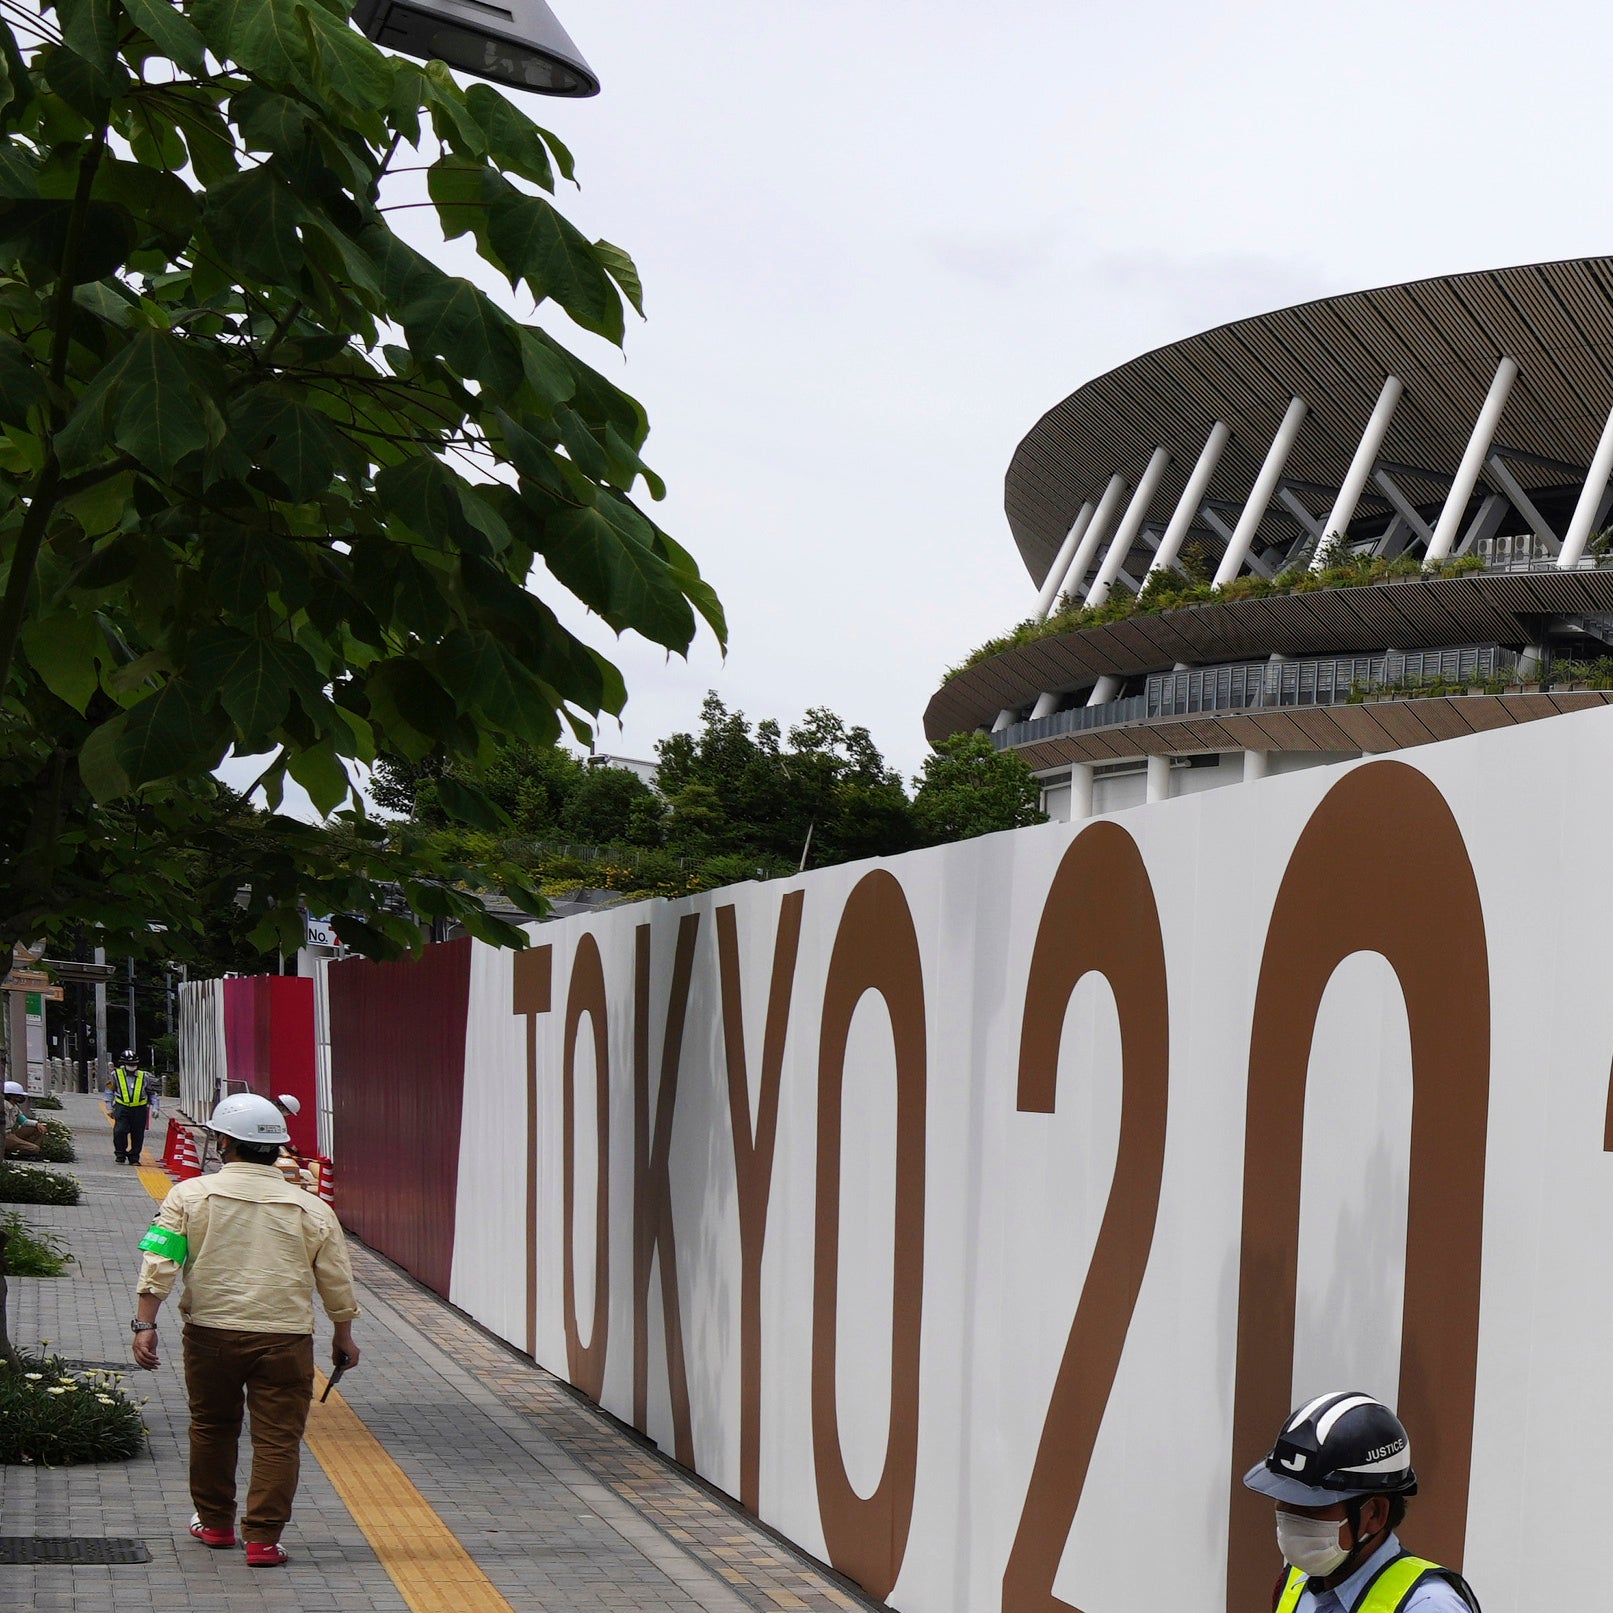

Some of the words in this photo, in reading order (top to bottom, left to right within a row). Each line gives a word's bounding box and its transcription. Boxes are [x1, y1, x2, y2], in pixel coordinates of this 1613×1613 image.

[309, 928, 328, 942] No.
[513, 867, 927, 1603] TOKYO
[1365, 1438, 1404, 1461] JUSTICE
[1280, 1453, 1307, 1471] J
